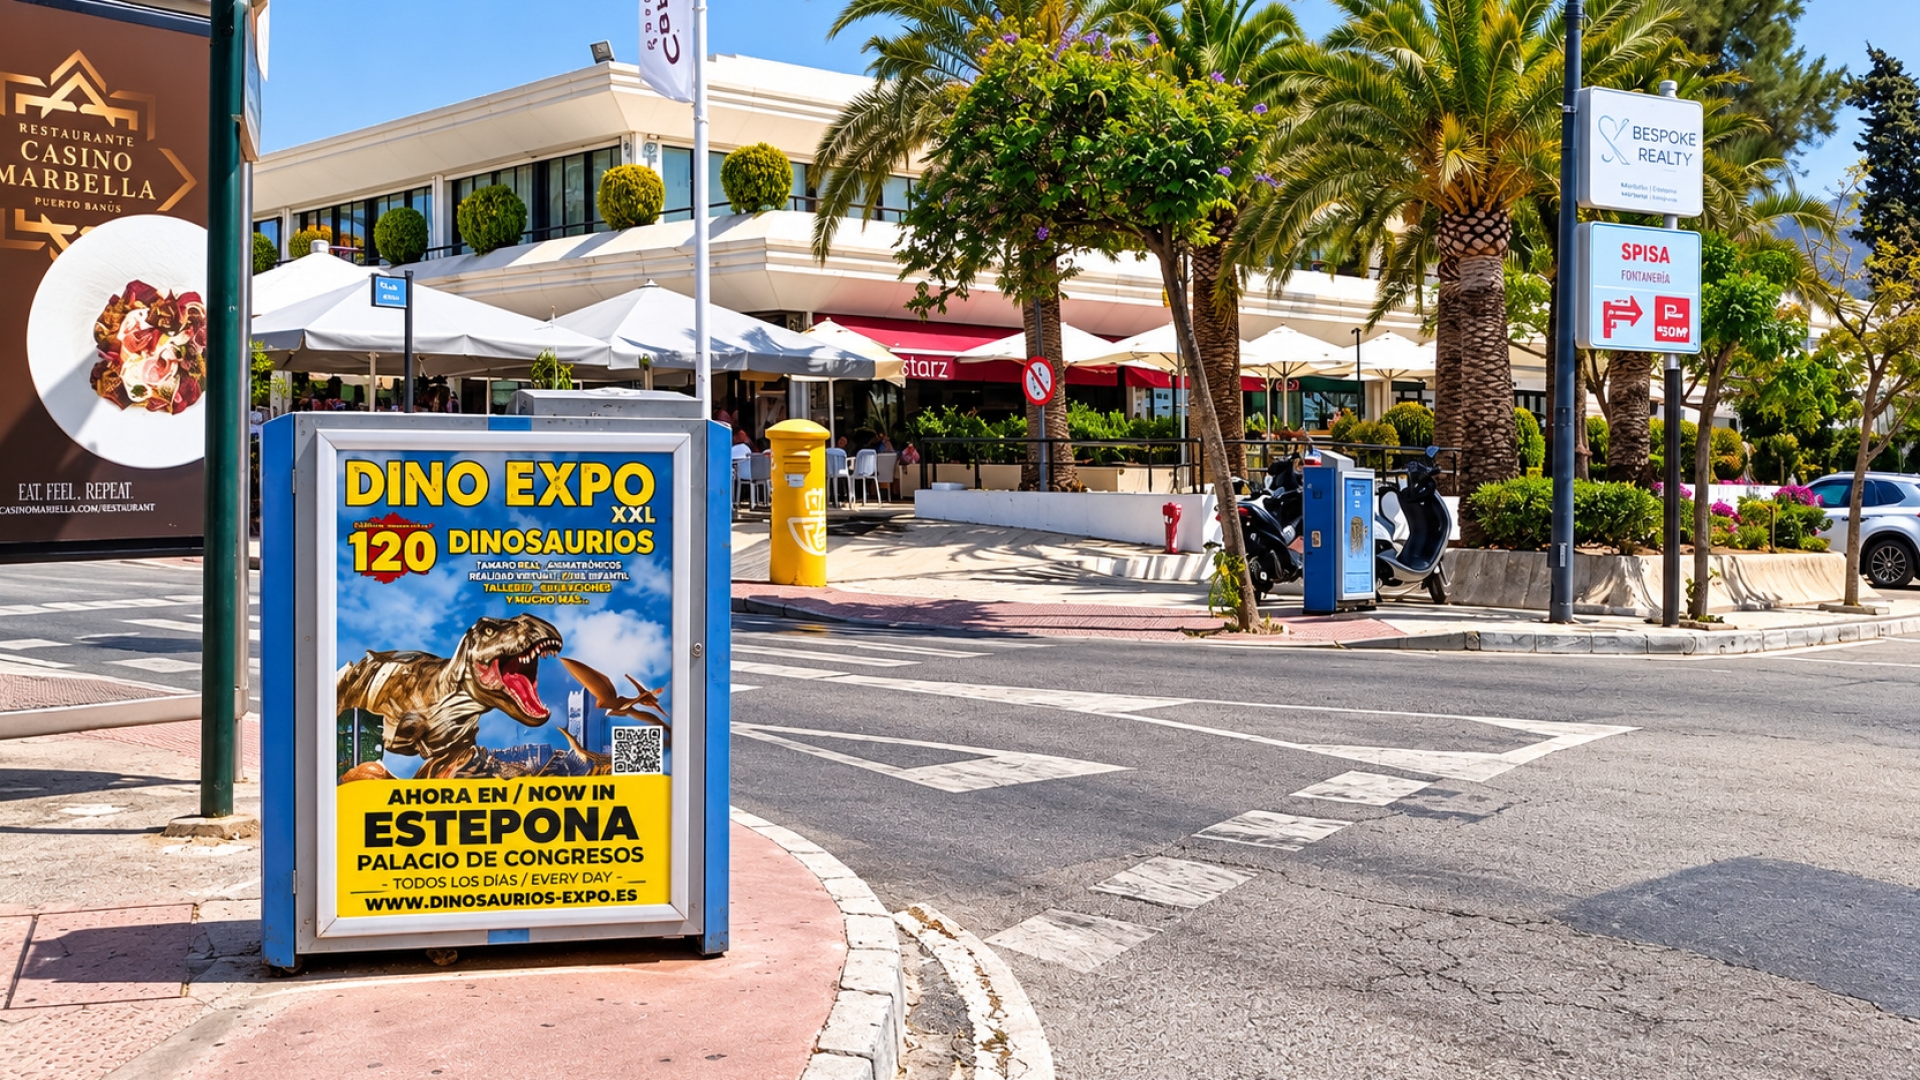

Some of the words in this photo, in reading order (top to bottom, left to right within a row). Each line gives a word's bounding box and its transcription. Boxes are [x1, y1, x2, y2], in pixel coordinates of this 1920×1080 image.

[19, 122, 135, 147] RESTAURANTE
[1633, 126, 1697, 147] BESPOKE
[21, 140, 133, 173] CASINO
[1638, 147, 1693, 167] REALTY
[0, 164, 157, 200] MARBELLA
[35, 196, 81, 210] PUERTO
[84, 200, 122, 213] BANÚS
[1621, 242, 1671, 264] SPISA
[1621, 269, 1671, 284] FONTANERÍA
[18, 483, 43, 501] EAT.
[85, 481, 134, 500] REPEAT.
[345, 459, 490, 507] DINO
[505, 460, 656, 507] EXPO
[611, 506, 656, 524] XXL
[347, 529, 438, 573] 120
[448, 529, 655, 555] DINOSAURIOS
[388, 788, 472, 805] AHORA
[478, 786, 508, 803] EN
[514, 783, 524, 805] /
[528, 785, 587, 802] NOW
[592, 784, 615, 800] IN
[364, 806, 639, 848] ESTEPONA
[357, 852, 459, 872] PALACIO
[467, 851, 497, 868] DE
[504, 847, 644, 867] CONGRESOS
[393, 876, 446, 890] TODOS
[451, 876, 480, 889] LOS
[484, 873, 518, 887] DÍAS
[531, 873, 579, 886] EVERY
[582, 871, 613, 884] DAY
[365, 889, 638, 911] WWW.DINOSAURIOS-EXPO.ES
